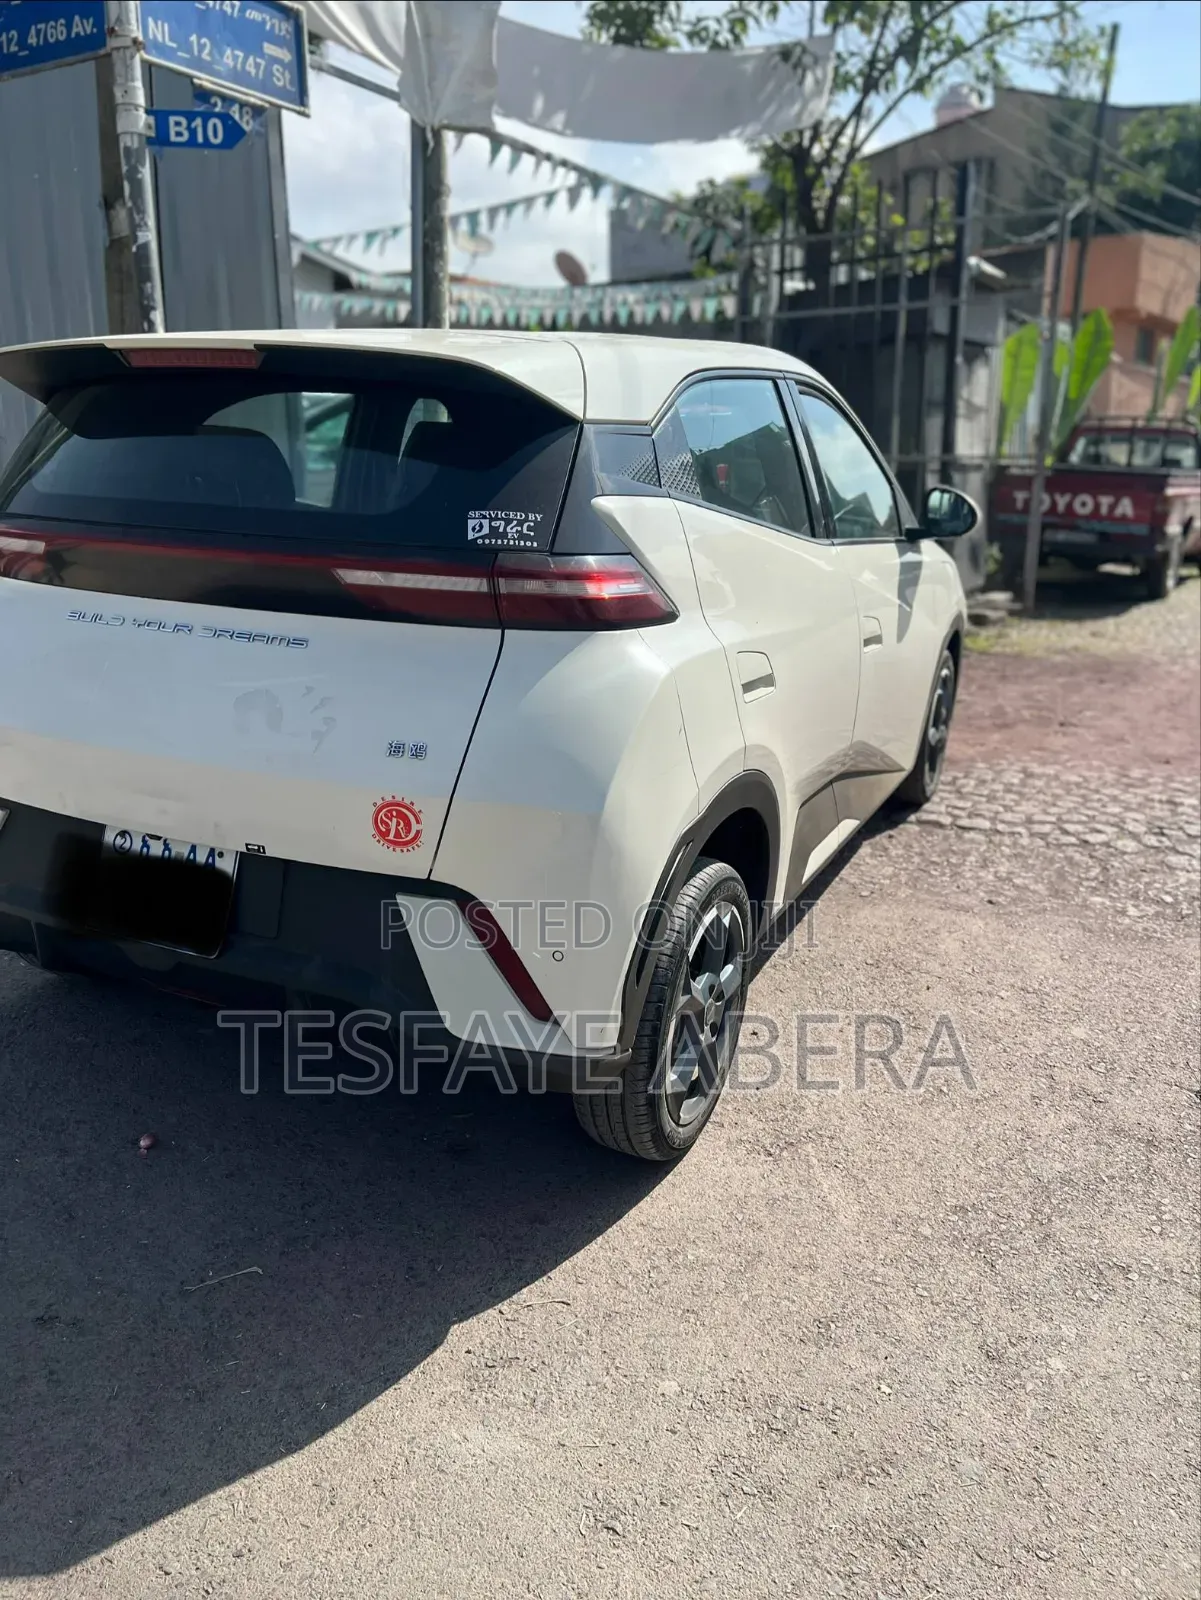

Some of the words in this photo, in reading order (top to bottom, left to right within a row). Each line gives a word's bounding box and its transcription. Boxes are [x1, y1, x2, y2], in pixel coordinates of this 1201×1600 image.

[70, 14, 97, 38] Av.
[147, 17, 266, 79] NL_12_4747
[271, 64, 296, 91] St.
[168, 116, 223, 145] B10
[467, 510, 526, 520] SERVICED
[528, 512, 544, 521] BY
[65, 609, 126, 626] BUILD
[131, 617, 194, 635] YOUR
[197, 624, 309, 649] DREAMS
[386, 740, 428, 760] 海鸥
